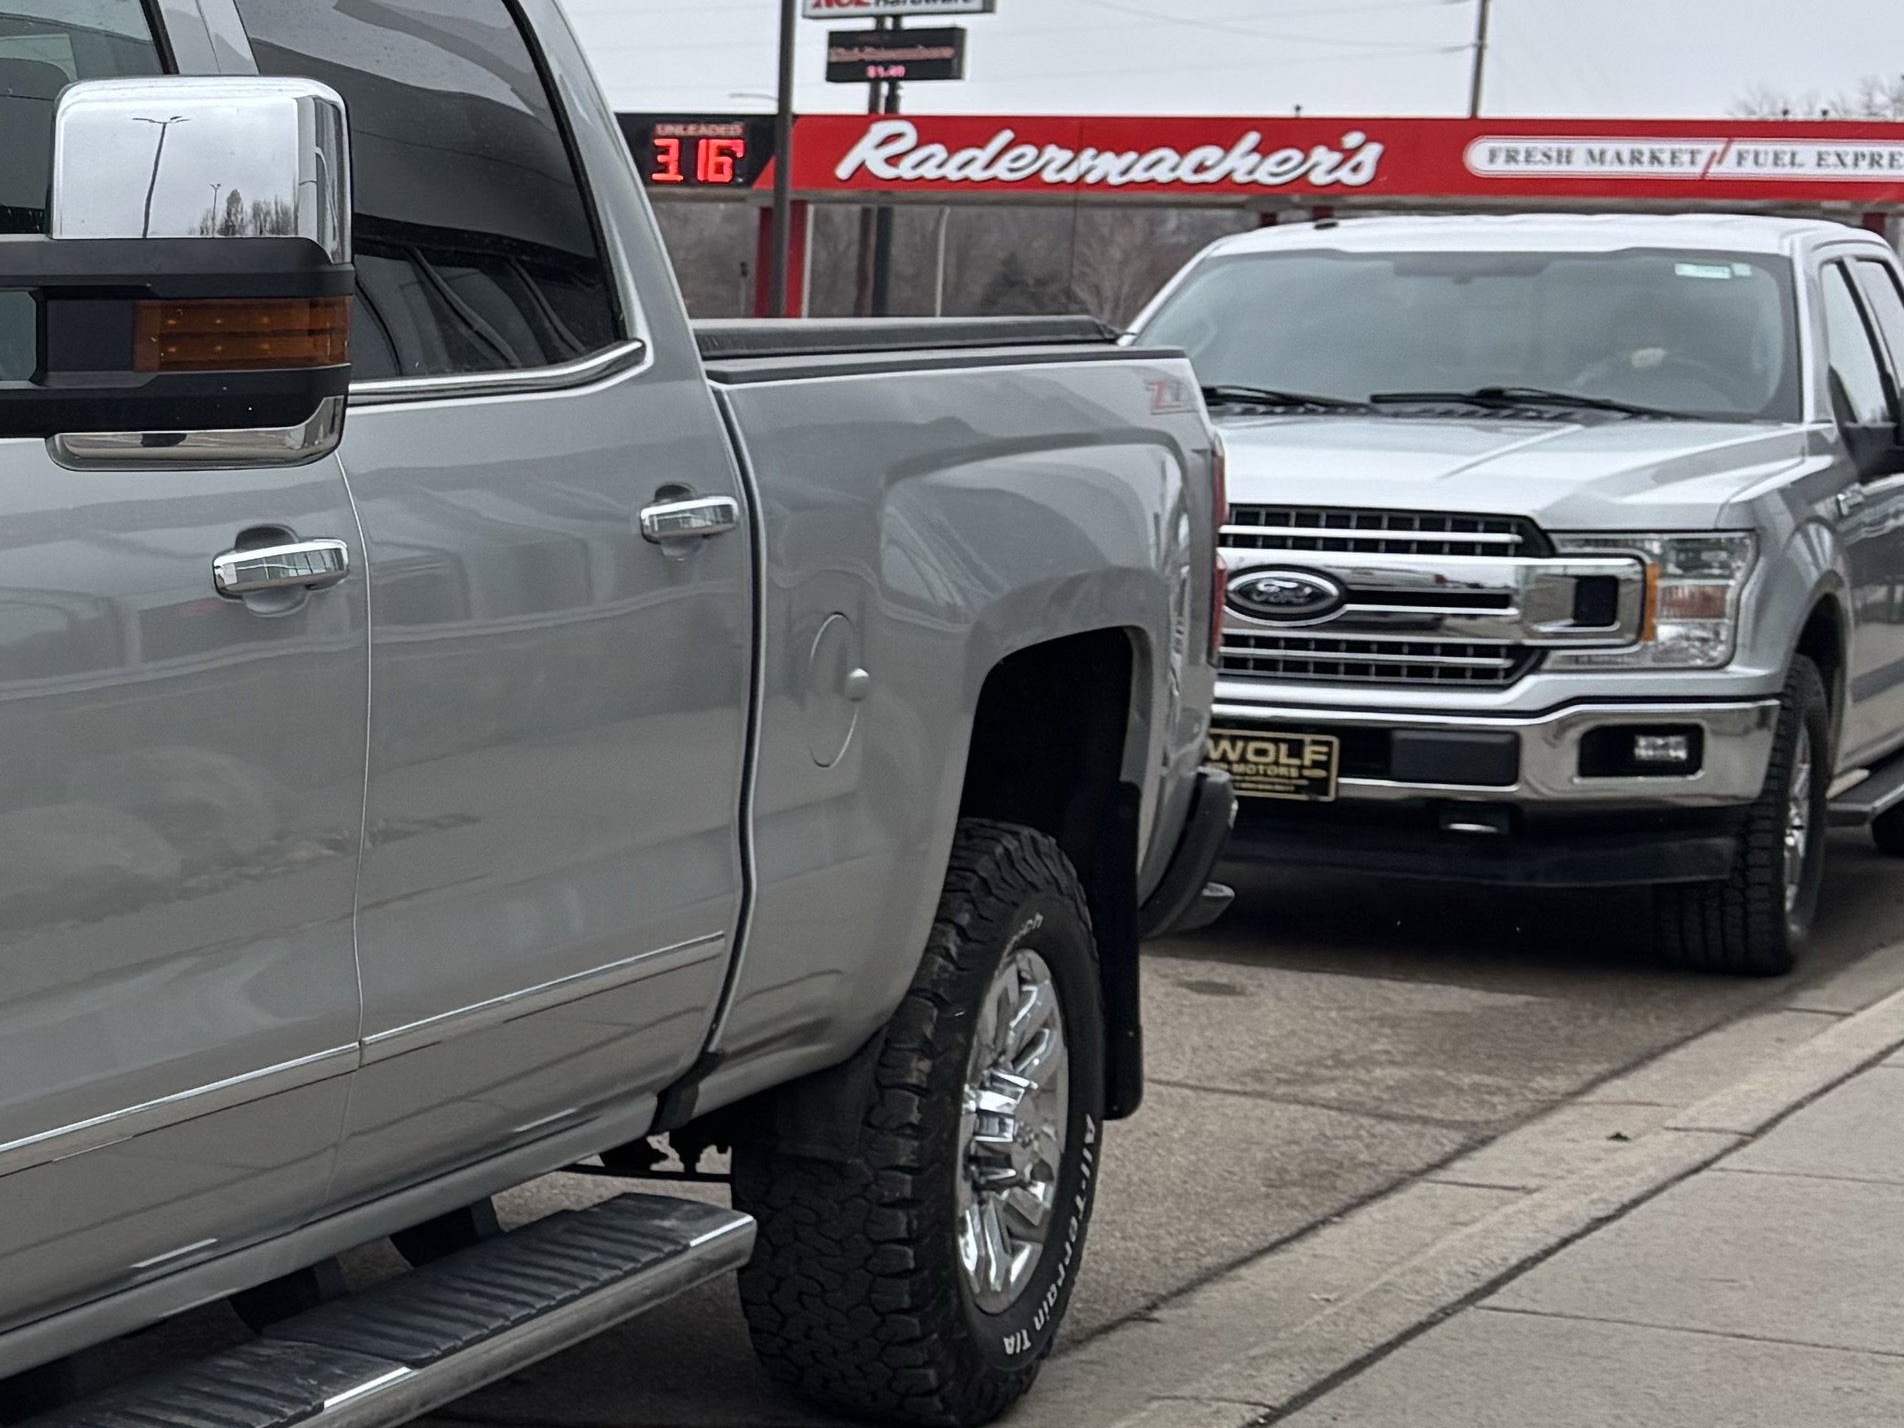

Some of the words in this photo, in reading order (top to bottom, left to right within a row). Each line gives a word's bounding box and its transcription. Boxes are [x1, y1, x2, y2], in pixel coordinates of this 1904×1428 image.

[834, 119, 1385, 186] Radermacher's
[1488, 146, 1574, 165] FRESH
[1585, 147, 1702, 167] MARKET
[1736, 149, 1805, 168] FUEL
[1206, 737, 1330, 766] WOLF
